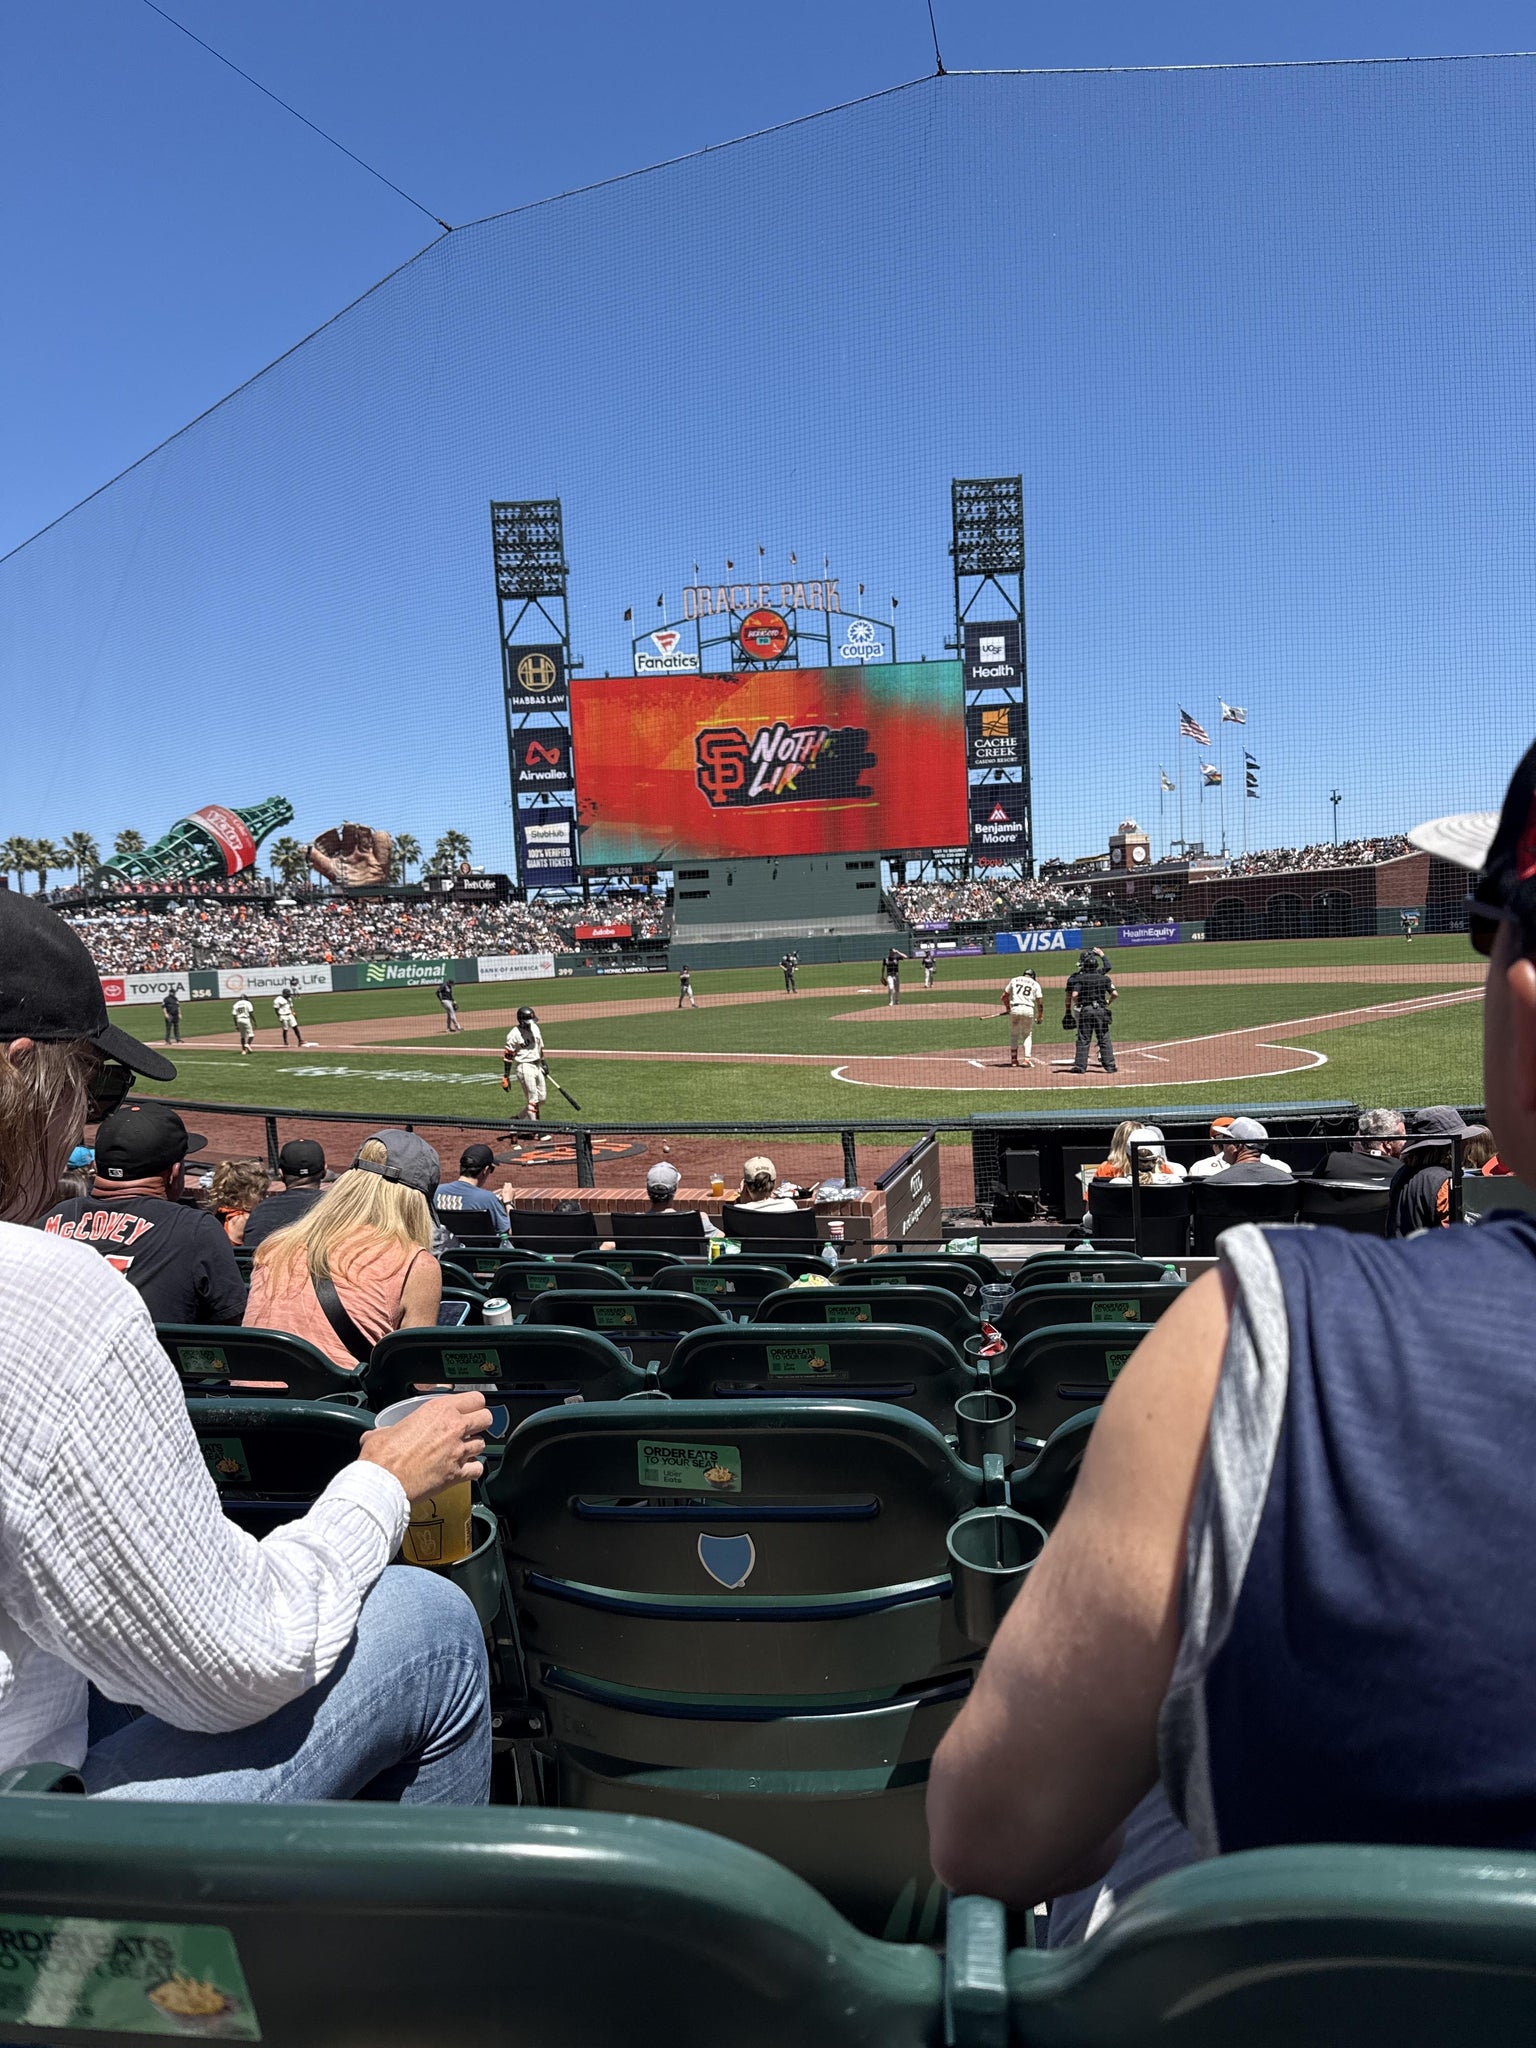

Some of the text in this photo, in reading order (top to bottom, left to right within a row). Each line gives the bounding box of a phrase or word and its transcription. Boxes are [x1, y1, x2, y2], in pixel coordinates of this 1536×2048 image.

[683, 578, 842, 620] ORACLE PARK
[842, 644, 881, 659] coupa
[981, 644, 1003, 654] UCSF
[637, 654, 698, 669] Fanatics
[972, 664, 1014, 678] Health
[513, 695, 565, 705] HABBAS LAW
[974, 737, 1017, 748] CACHE
[976, 746, 1017, 758] CREEK
[519, 769, 568, 781] Airwallex
[531, 829, 565, 839] StubHub
[974, 821, 1023, 835] Benjamin
[528, 847, 571, 858] 100% VERIFIED
[526, 857, 573, 868] GIANTS TICKETS
[1122, 927, 1177, 938] HealthEquity
[1012, 931, 1067, 952] VISA
[386, 962, 447, 980] National
[557, 968, 573, 976] 399
[302, 975, 327, 985] Life
[421, 977, 444, 986] Rental
[130, 983, 185, 995] TOYOTA
[191, 989, 212, 999] 354
[1015, 984, 1032, 996] 78
[644, 1446, 718, 1461] ORDER EATS
[645, 1455, 718, 1469] TO YOUR SEAT
